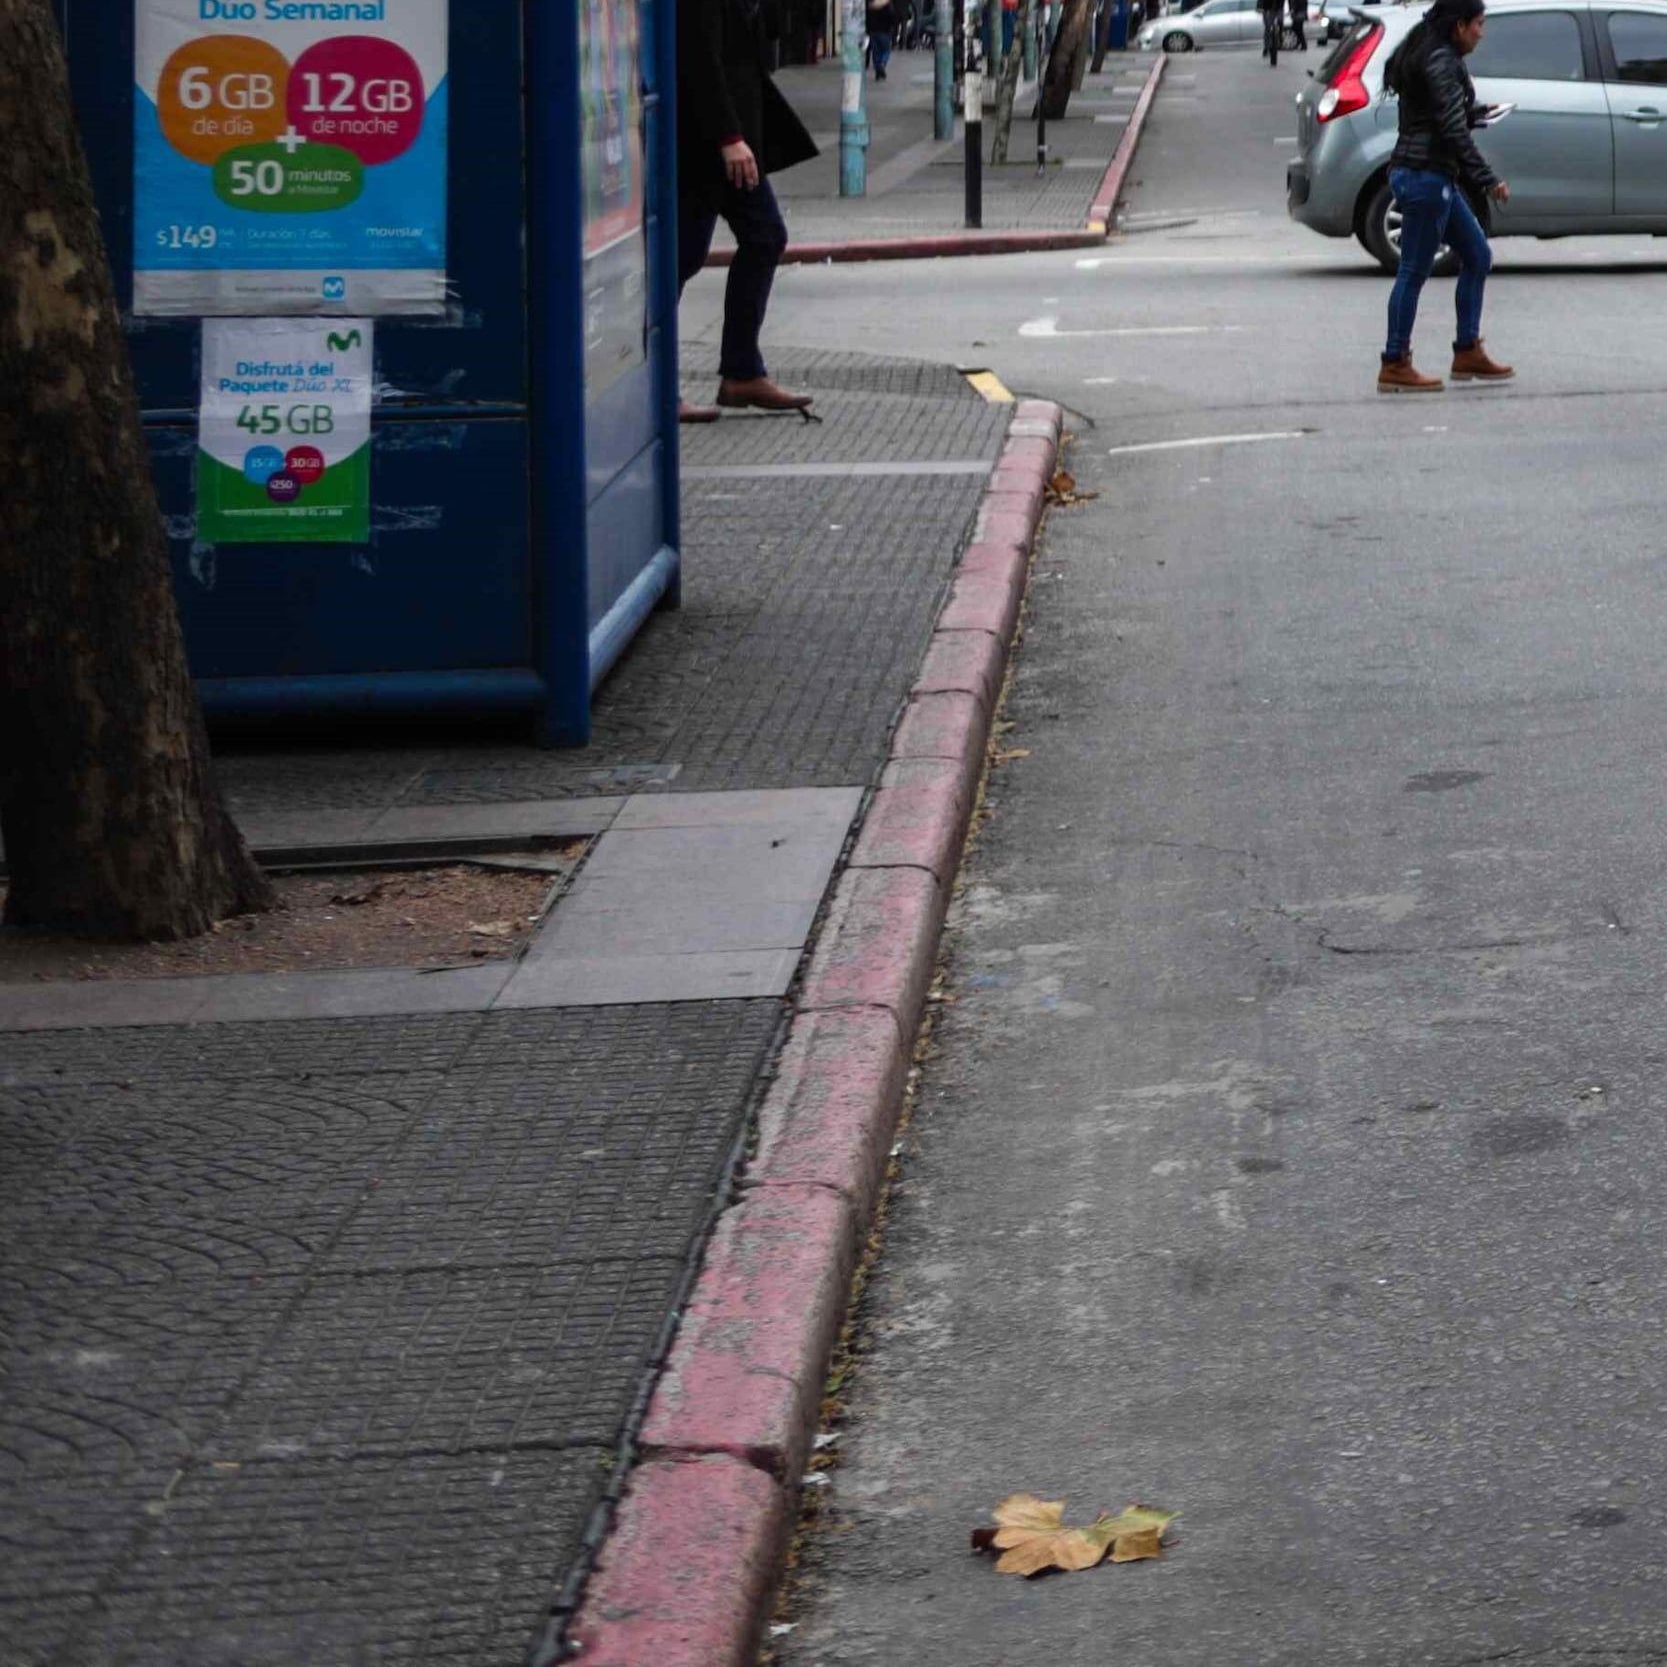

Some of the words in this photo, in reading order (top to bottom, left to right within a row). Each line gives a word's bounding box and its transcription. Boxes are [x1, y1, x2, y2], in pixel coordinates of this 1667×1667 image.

[179, 66, 213, 110] 6
[219, 74, 275, 109] GB
[302, 73, 356, 112] 12
[361, 80, 413, 113] GB
[193, 117, 218, 135] de
[223, 116, 254, 135] día
[312, 117, 336, 134] de
[340, 117, 399, 134] noche
[231, 160, 284, 195] 50
[288, 168, 352, 183] minutos
[157, 224, 217, 249] $149
[309, 362, 334, 376] del
[219, 378, 289, 394] Paquete
[236, 405, 281, 434] 45
[287, 404, 334, 434] GB
